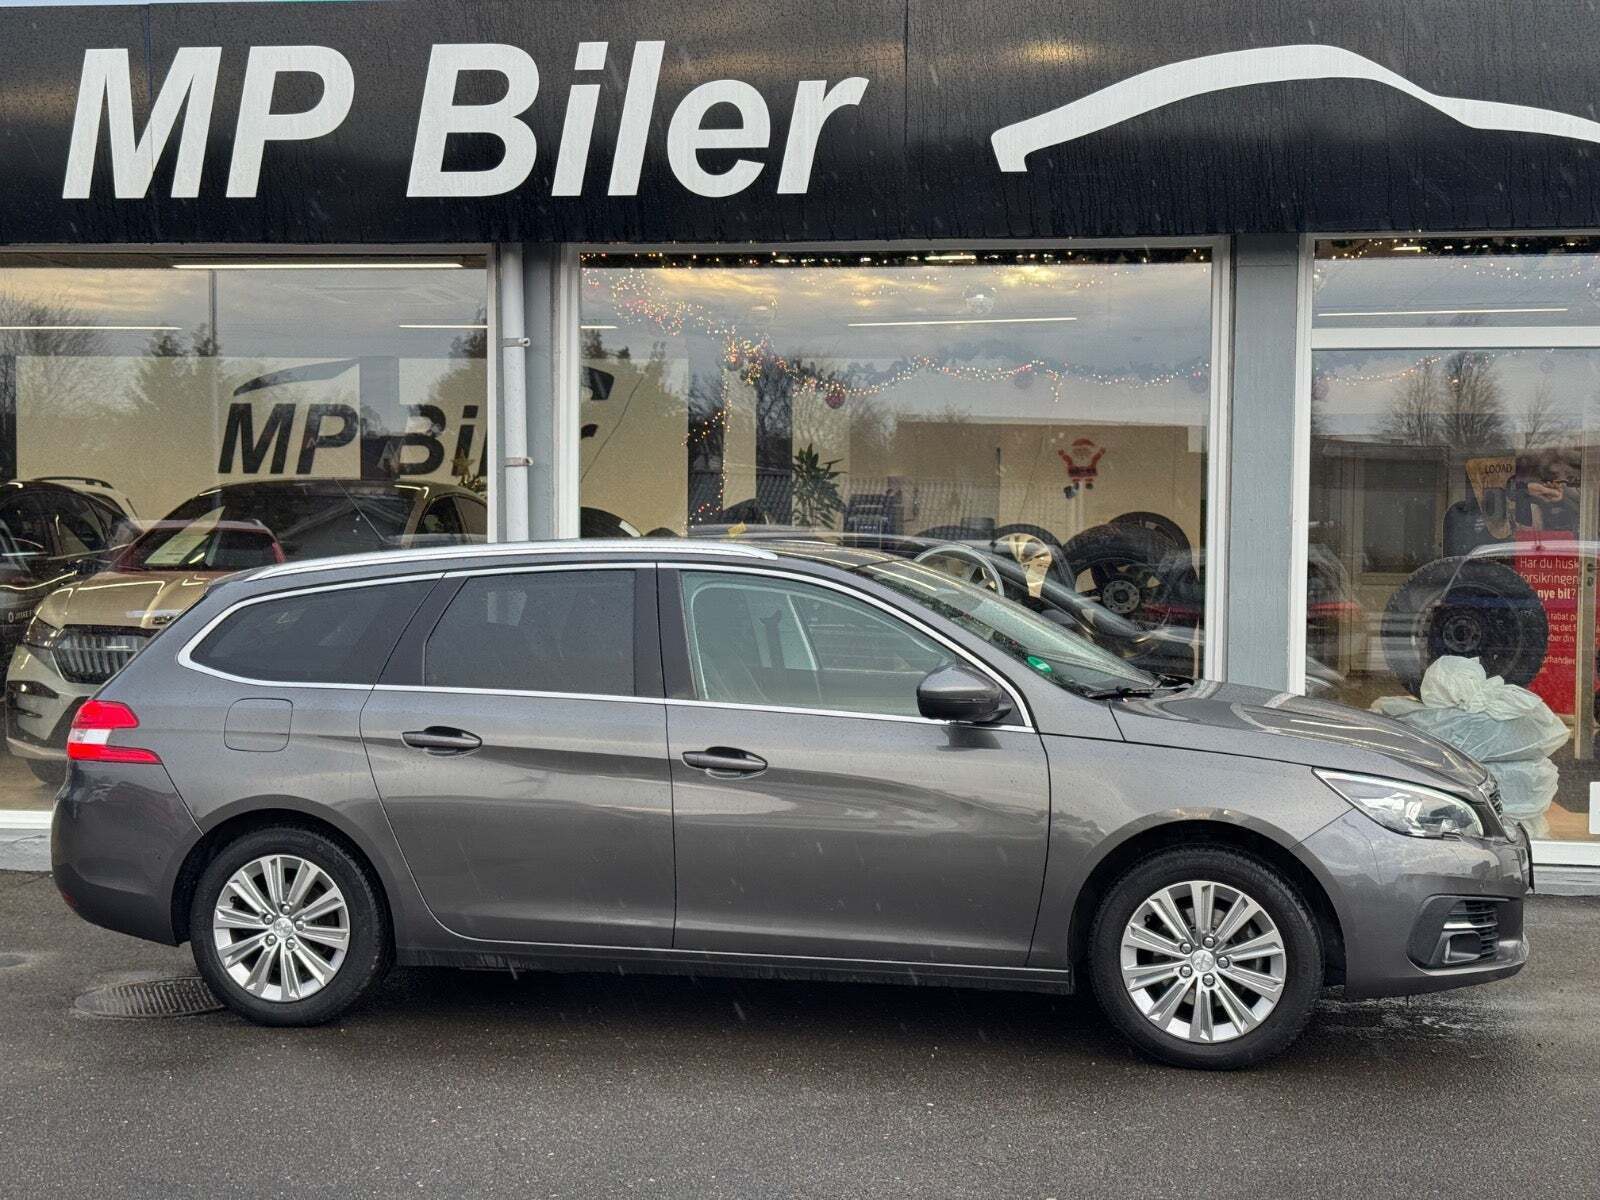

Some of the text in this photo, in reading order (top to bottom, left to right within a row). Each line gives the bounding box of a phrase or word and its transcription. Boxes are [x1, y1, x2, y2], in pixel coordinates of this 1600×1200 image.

[62, 40, 869, 199] MP Biler
[218, 403, 358, 475] MP
[1520, 557, 1537, 569] Har
[1540, 557, 1553, 569] du
[1538, 588, 1576, 601] nye bil?
